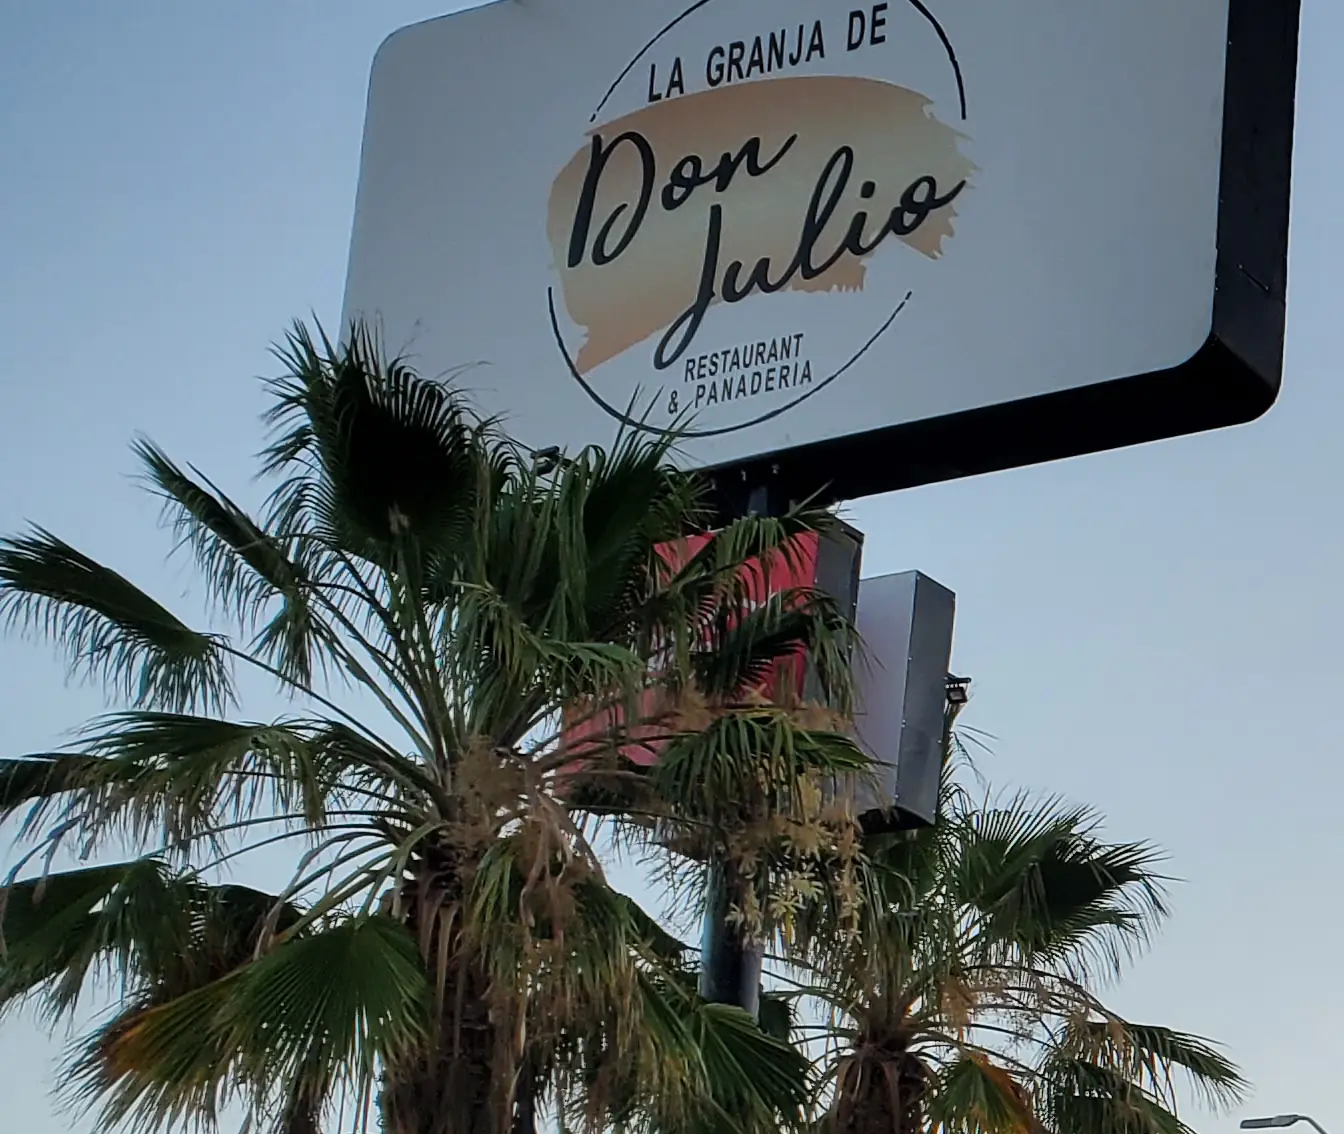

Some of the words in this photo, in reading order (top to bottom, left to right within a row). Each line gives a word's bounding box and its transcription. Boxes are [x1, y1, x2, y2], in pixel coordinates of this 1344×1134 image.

[648, 56, 685, 103] LA
[705, 19, 825, 88] GRANJA
[846, 2, 889, 52] DE
[567, 130, 798, 268] Don
[653, 144, 967, 370] Julio
[667, 389, 679, 416] &
[694, 359, 813, 409] PANADERIA
[684, 333, 804, 383] RESTAURANT
